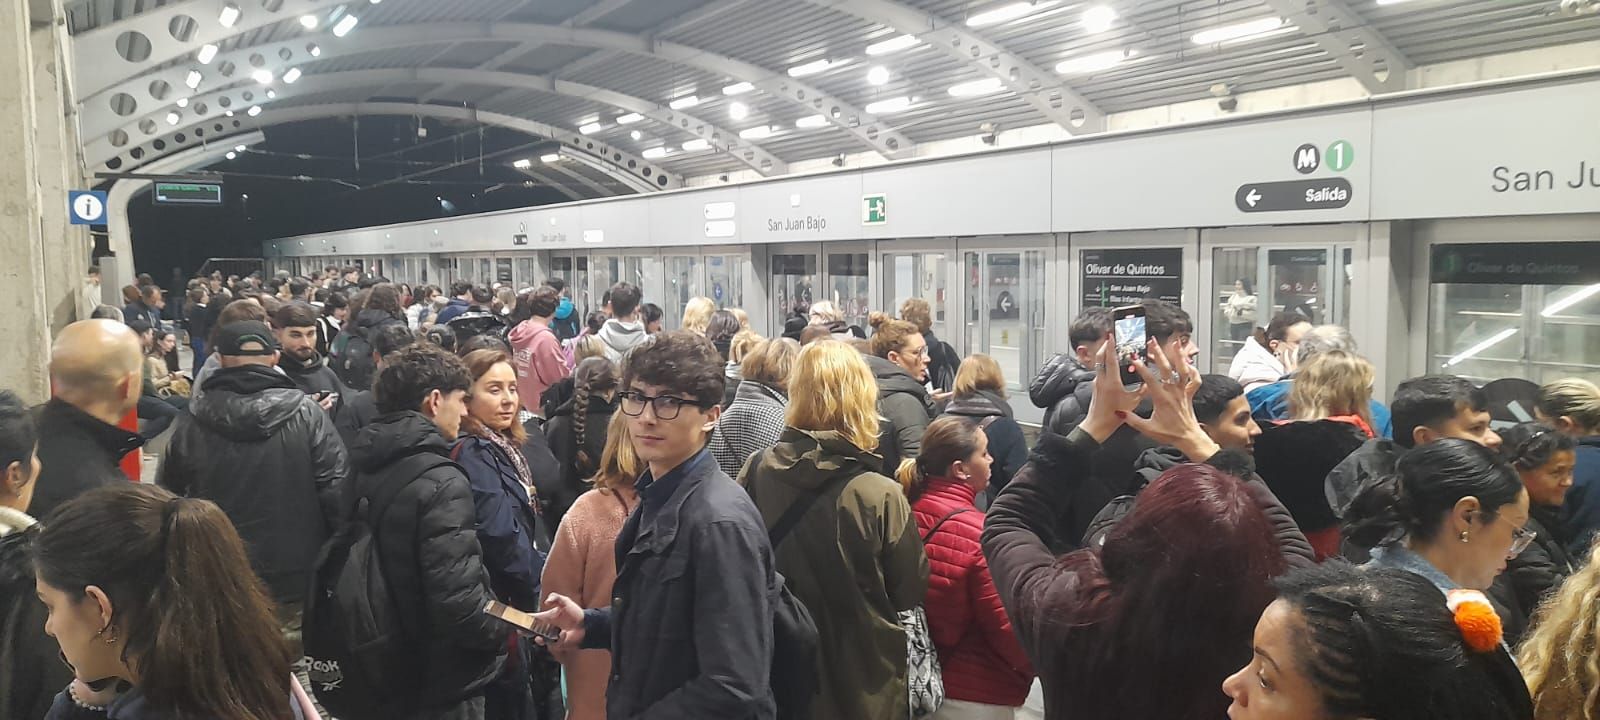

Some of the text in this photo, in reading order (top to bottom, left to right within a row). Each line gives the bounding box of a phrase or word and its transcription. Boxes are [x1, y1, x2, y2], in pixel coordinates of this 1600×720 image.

[1297, 142, 1344, 169] M 1
[1491, 166, 1554, 193] San
[1305, 186, 1347, 202] Salida
[768, 216, 826, 233] San Juan Bajo
[1085, 263, 1165, 275] Olivar de Quintos
